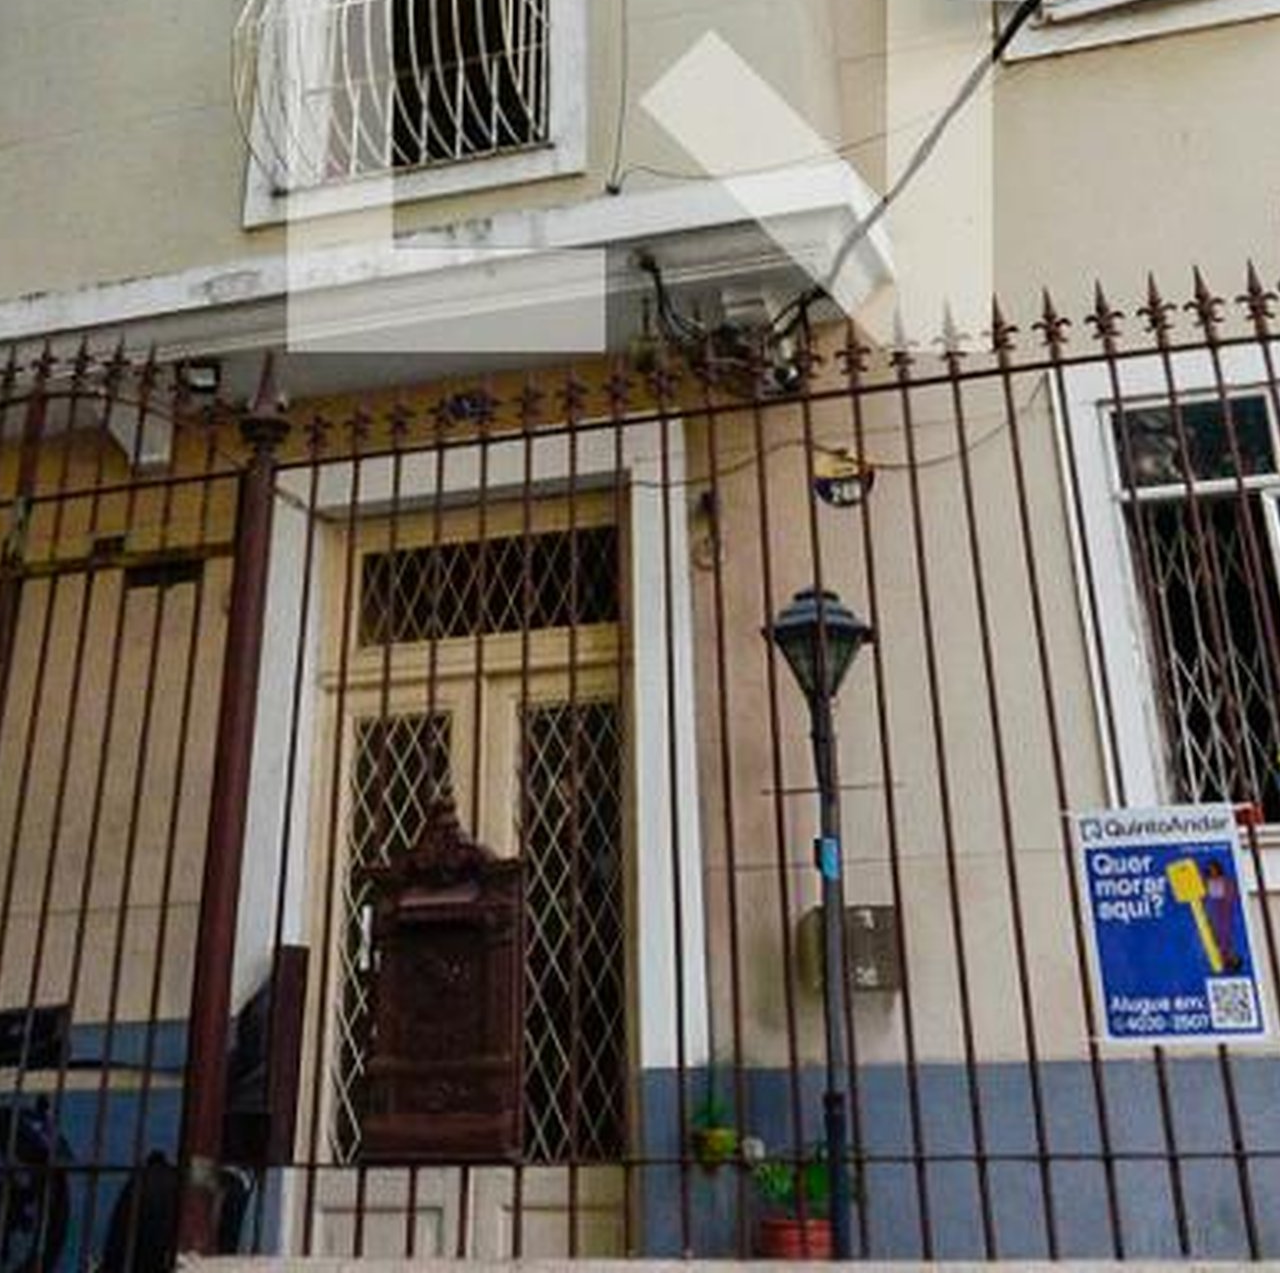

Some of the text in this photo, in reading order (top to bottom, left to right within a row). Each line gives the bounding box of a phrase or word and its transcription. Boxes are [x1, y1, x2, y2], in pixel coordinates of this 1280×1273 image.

[1105, 815, 1228, 837] QuintoAndar
[1092, 853, 1153, 875] Quer
[1095, 877, 1165, 896] morar
[1098, 894, 1164, 922] aqui?
